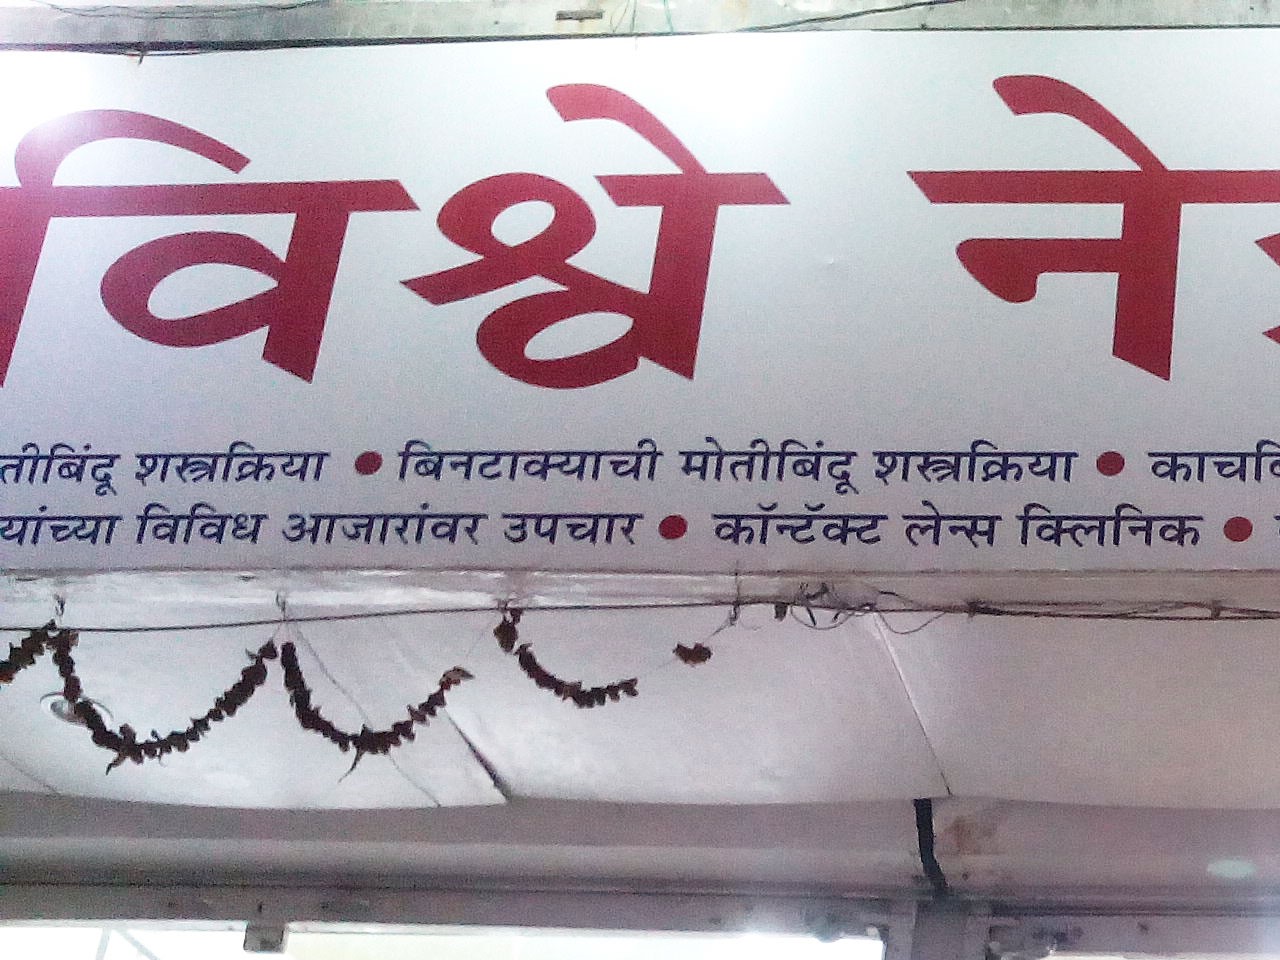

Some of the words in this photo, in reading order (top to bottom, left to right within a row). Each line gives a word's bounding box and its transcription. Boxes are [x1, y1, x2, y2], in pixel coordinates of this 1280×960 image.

[135, 442, 330, 485] शस्त्रक्रिया
[398, 439, 665, 482] बिनटाक्याची
[679, 437, 860, 495] मोतीबिंदू
[872, 440, 1079, 485] शस्त्रक्रिया
[135, 503, 269, 545] विविध
[281, 503, 489, 546] आजारांवर
[502, 513, 645, 546] उपचार
[711, 503, 889, 546] कॉन्टॅक्ट
[902, 500, 1003, 548] लेन्स
[1016, 503, 1205, 548] क्लिनिक
